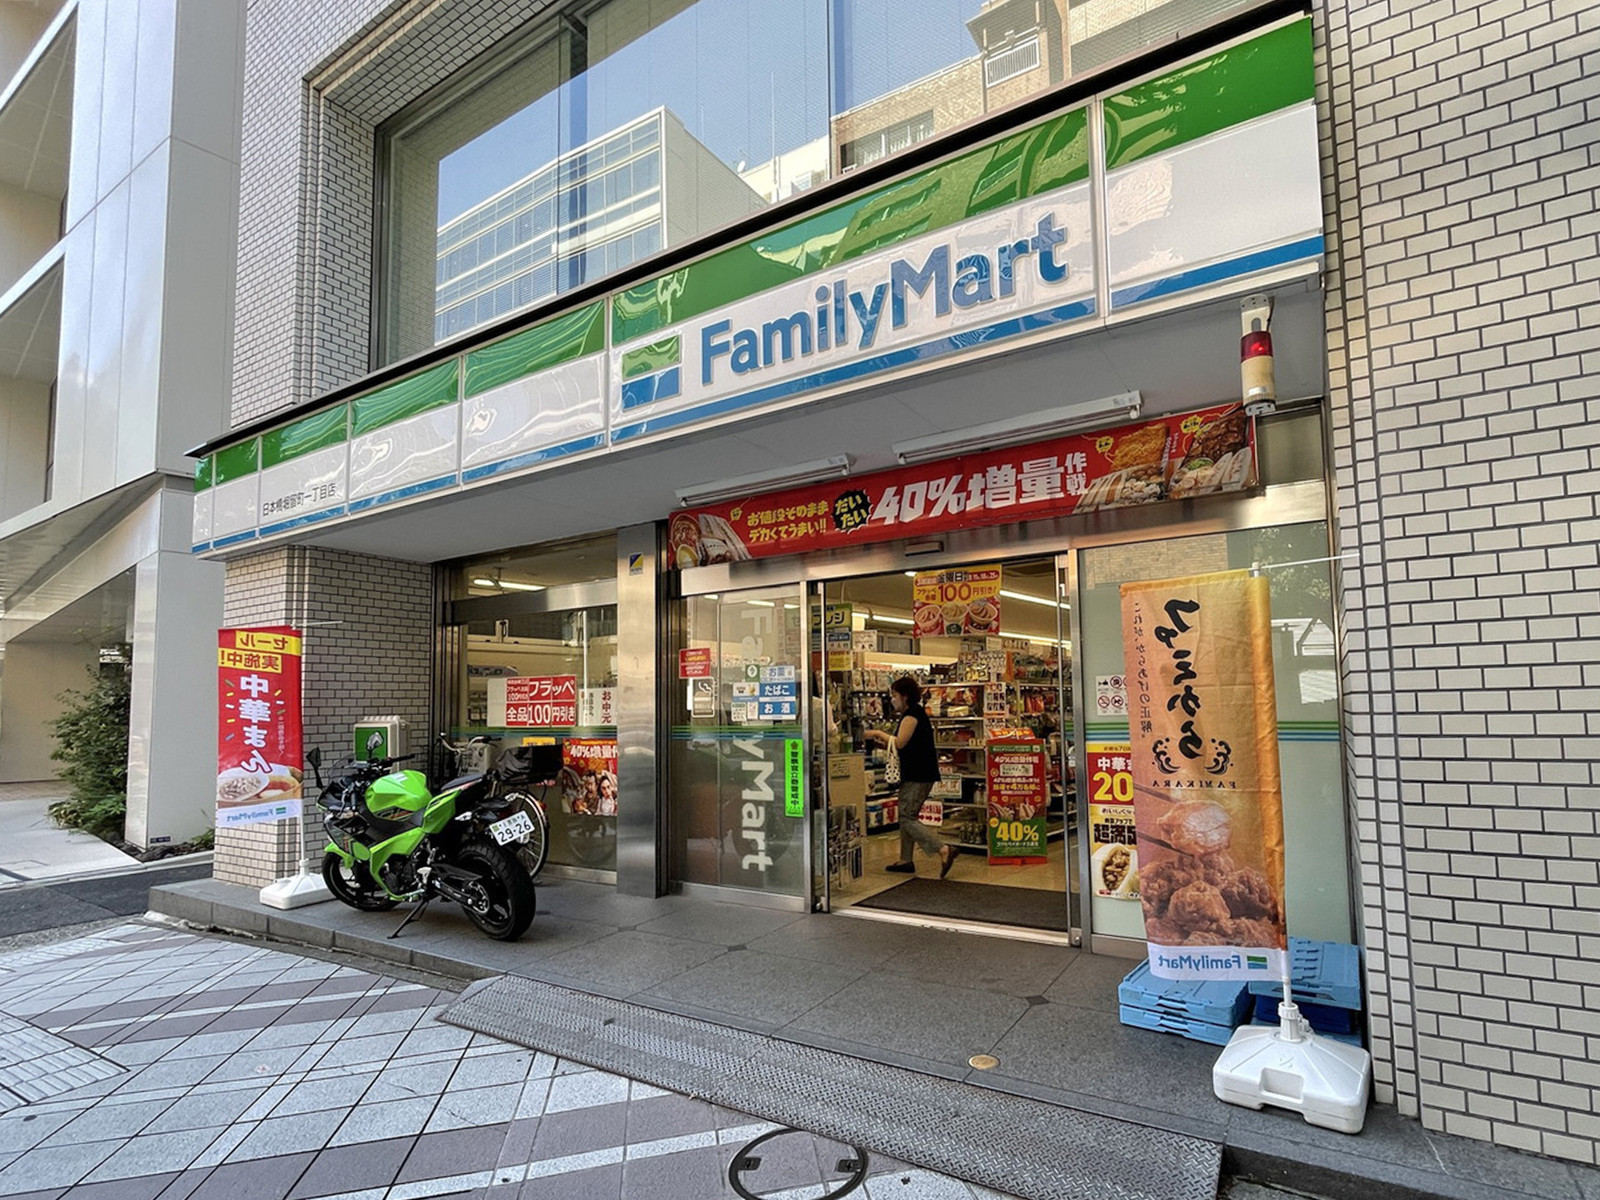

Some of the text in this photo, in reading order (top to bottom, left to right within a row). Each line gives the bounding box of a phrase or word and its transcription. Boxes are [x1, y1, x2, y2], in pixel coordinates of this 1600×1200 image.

[701, 213, 1068, 386] FamilyMart
[871, 451, 1088, 524] 40%増量 作戦
[747, 500, 829, 526] お値段そのまま
[529, 680, 575, 697] フラッペ
[765, 685, 790, 696] たばこ
[507, 705, 575, 724] 全品100円引き
[602, 691, 612, 724] お中元
[1093, 772, 1133, 802] 20
[996, 821, 1039, 842] 40%
